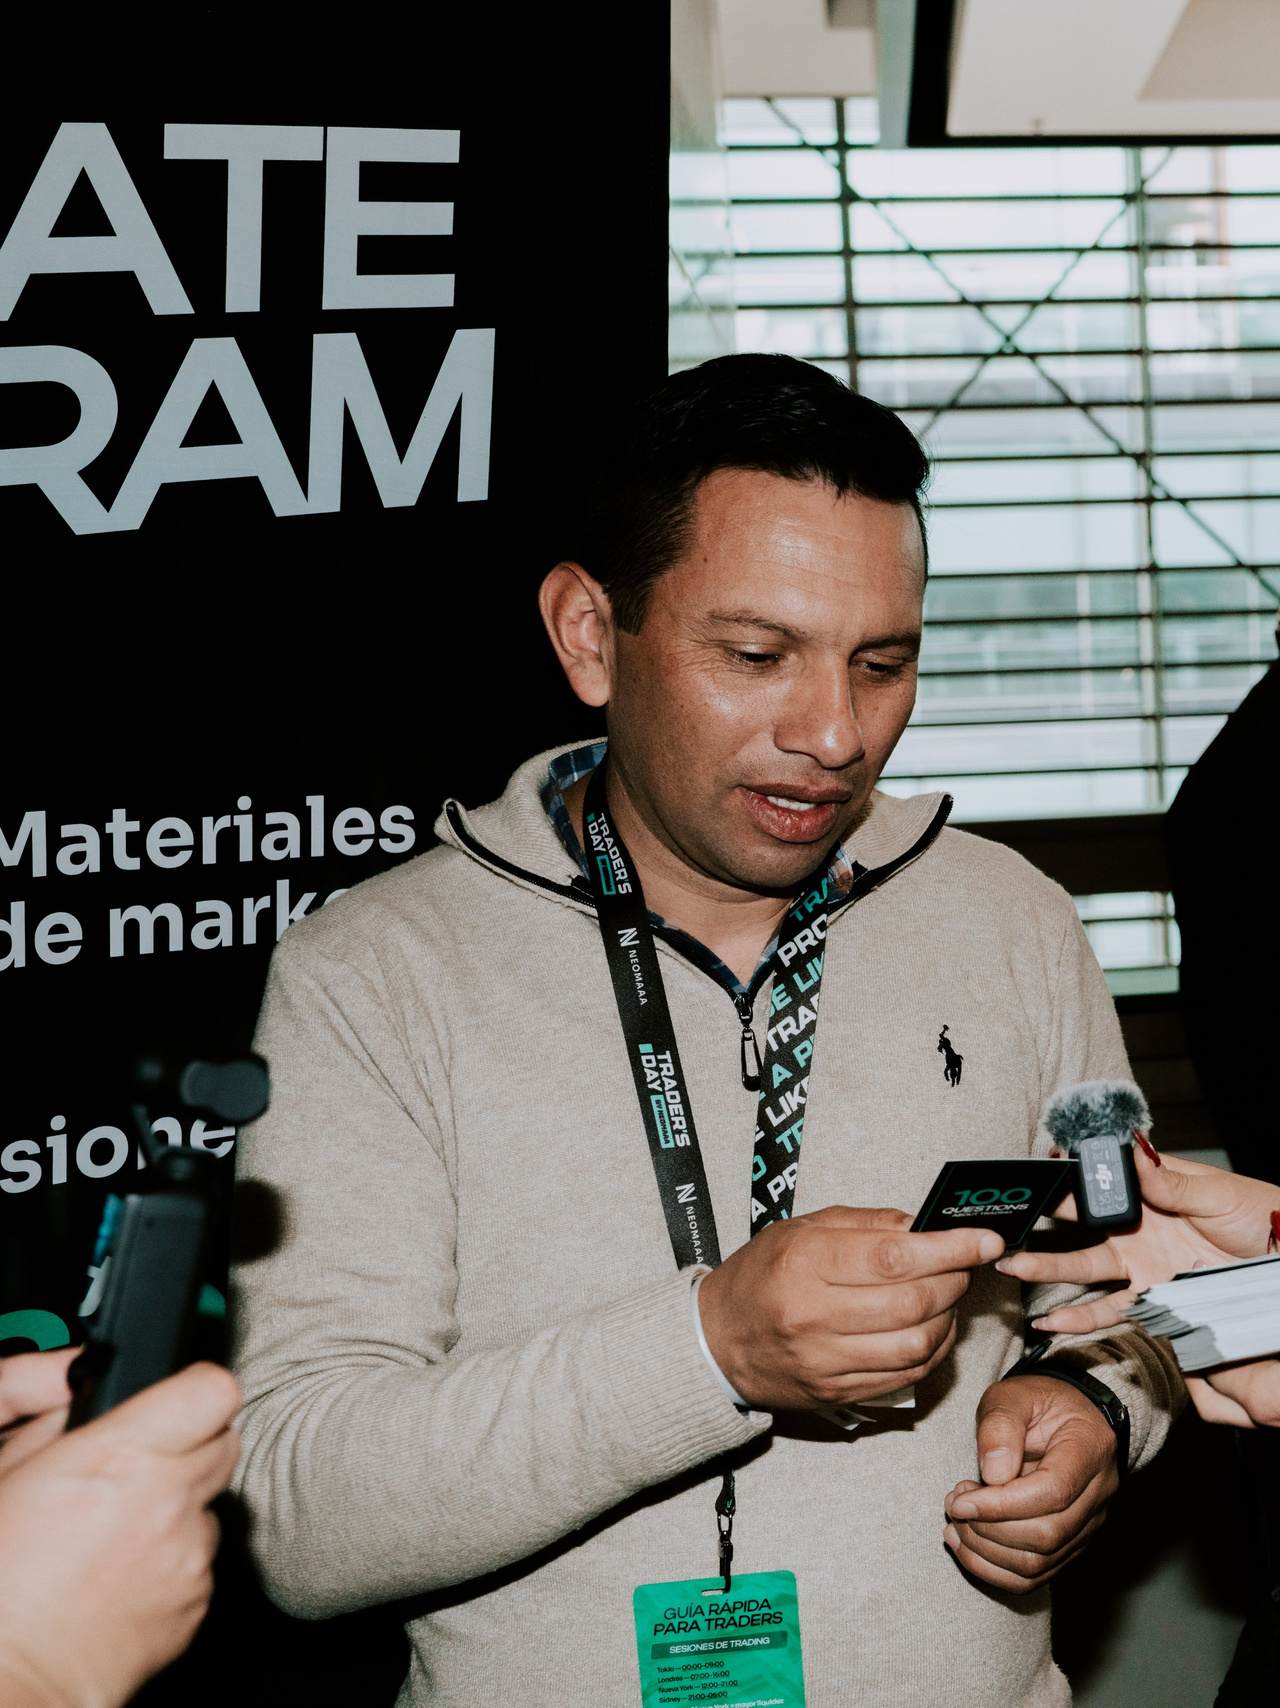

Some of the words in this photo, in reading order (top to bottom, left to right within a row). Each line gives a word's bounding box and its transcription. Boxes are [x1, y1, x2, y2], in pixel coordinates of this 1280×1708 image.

[0, 122, 461, 321] ATE
[0, 328, 496, 535] RAM
[0, 795, 416, 878] Materiales
[587, 821, 607, 852] DAY
[597, 813, 632, 895] TRADER'S
[0, 900, 83, 972] de
[109, 879, 350, 958] mark
[628, 950, 648, 1006] NEOMAAA
[767, 993, 819, 1052] TRA
[640, 1055, 662, 1092] DAY
[771, 1063, 793, 1089] A
[793, 1034, 815, 1068] P
[656, 1050, 691, 1147] TRADER'S
[942, 1203, 1030, 1215] QUESTIONS
[954, 1187, 1032, 1206] 100
[685, 1206, 704, 1264] NEOMAAA
[653, 1620, 701, 1636] PARA
[704, 1611, 784, 1631] TRADERS
[664, 1602, 705, 1620] GUÍA
[708, 1598, 772, 1616] RÁPIDA
[669, 1642, 715, 1654] SESIONES
[715, 1640, 728, 1650] DE
[729, 1636, 770, 1648] TRADING
[657, 1676, 684, 1684] Londres
[658, 1686, 679, 1694] Nueva
[680, 1684, 694, 1692] York
